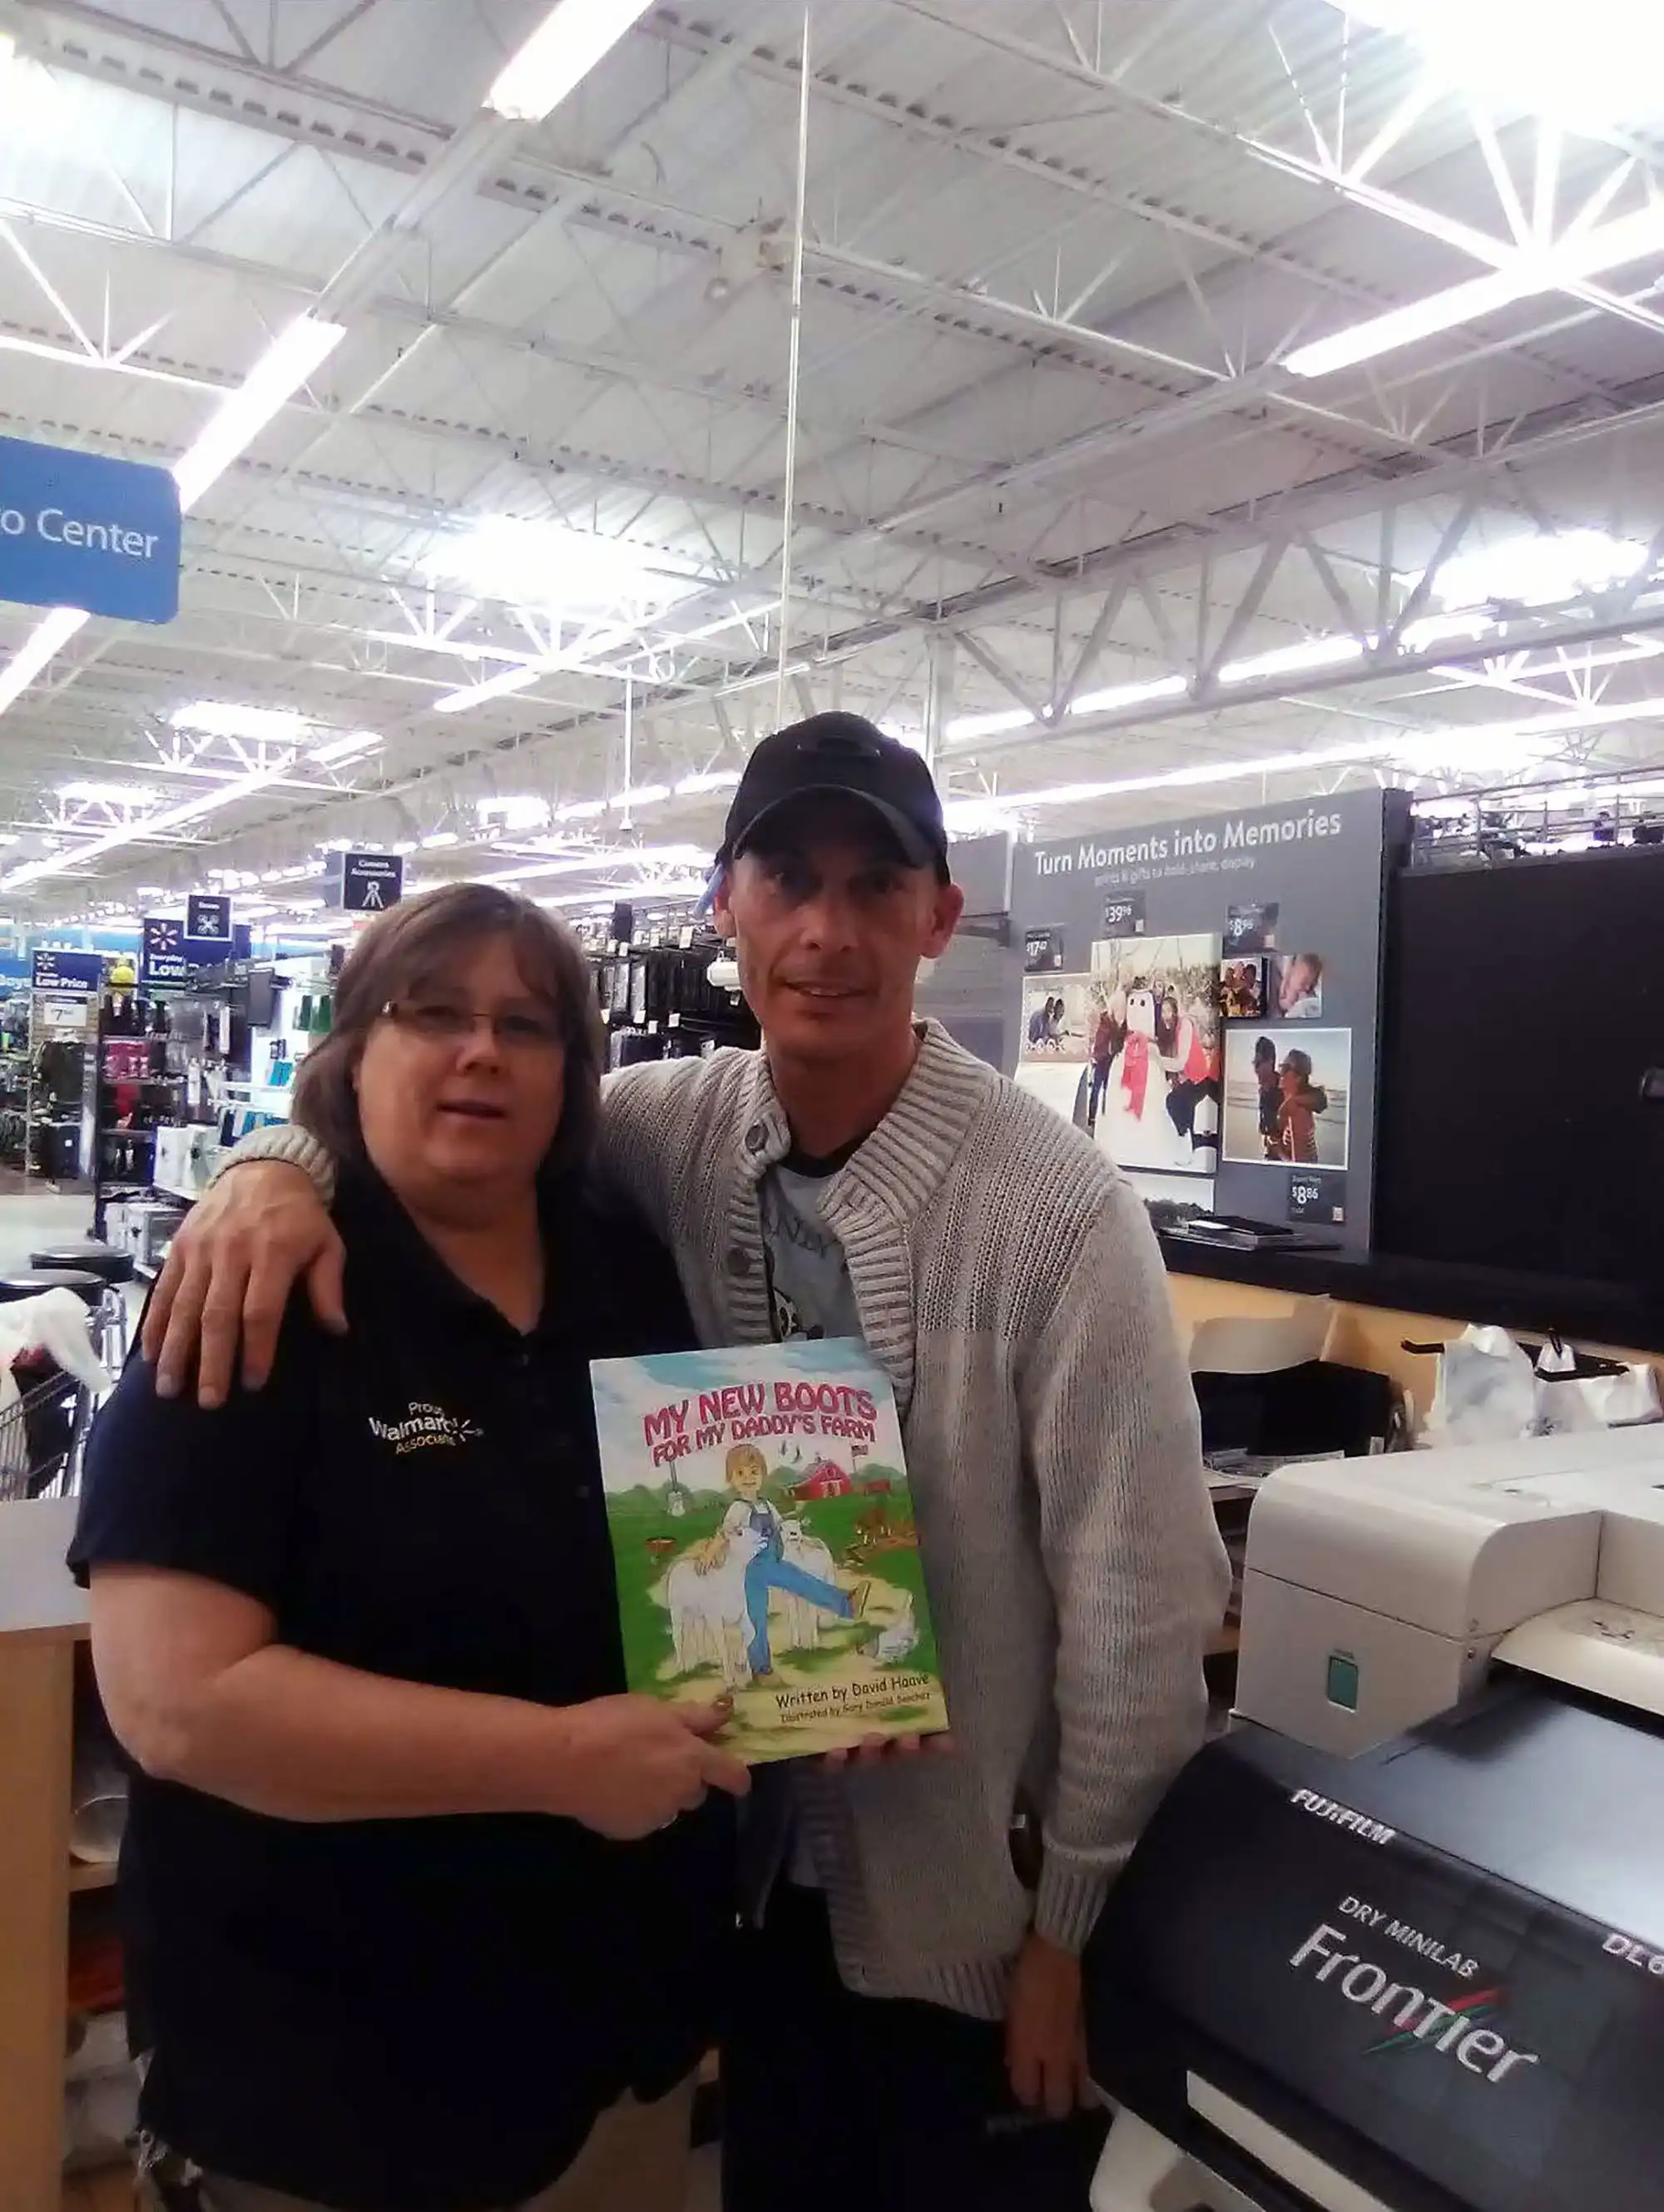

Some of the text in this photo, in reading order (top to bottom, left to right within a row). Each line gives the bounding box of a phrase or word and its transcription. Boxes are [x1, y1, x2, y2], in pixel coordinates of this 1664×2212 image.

[0, 507, 160, 558] o Center
[1035, 850, 1072, 875] Turn
[1077, 834, 1168, 870] Moments
[1173, 829, 1217, 857] into
[1223, 808, 1342, 849] Memories
[149, 961, 185, 977] Low
[368, 1416, 450, 1442] Walmart
[642, 1381, 878, 1446] MY NEW BOOTS
[653, 1414, 876, 1467] FOR MY DADDY'S FARM
[775, 1690, 829, 1710] Written
[831, 1685, 849, 1703] by
[851, 1680, 888, 1697] David
[1290, 1789, 1397, 1844] FUJIFILM
[1338, 1896, 1480, 1979] DRY MINILAB
[1289, 1923, 1539, 2083] Frontier
